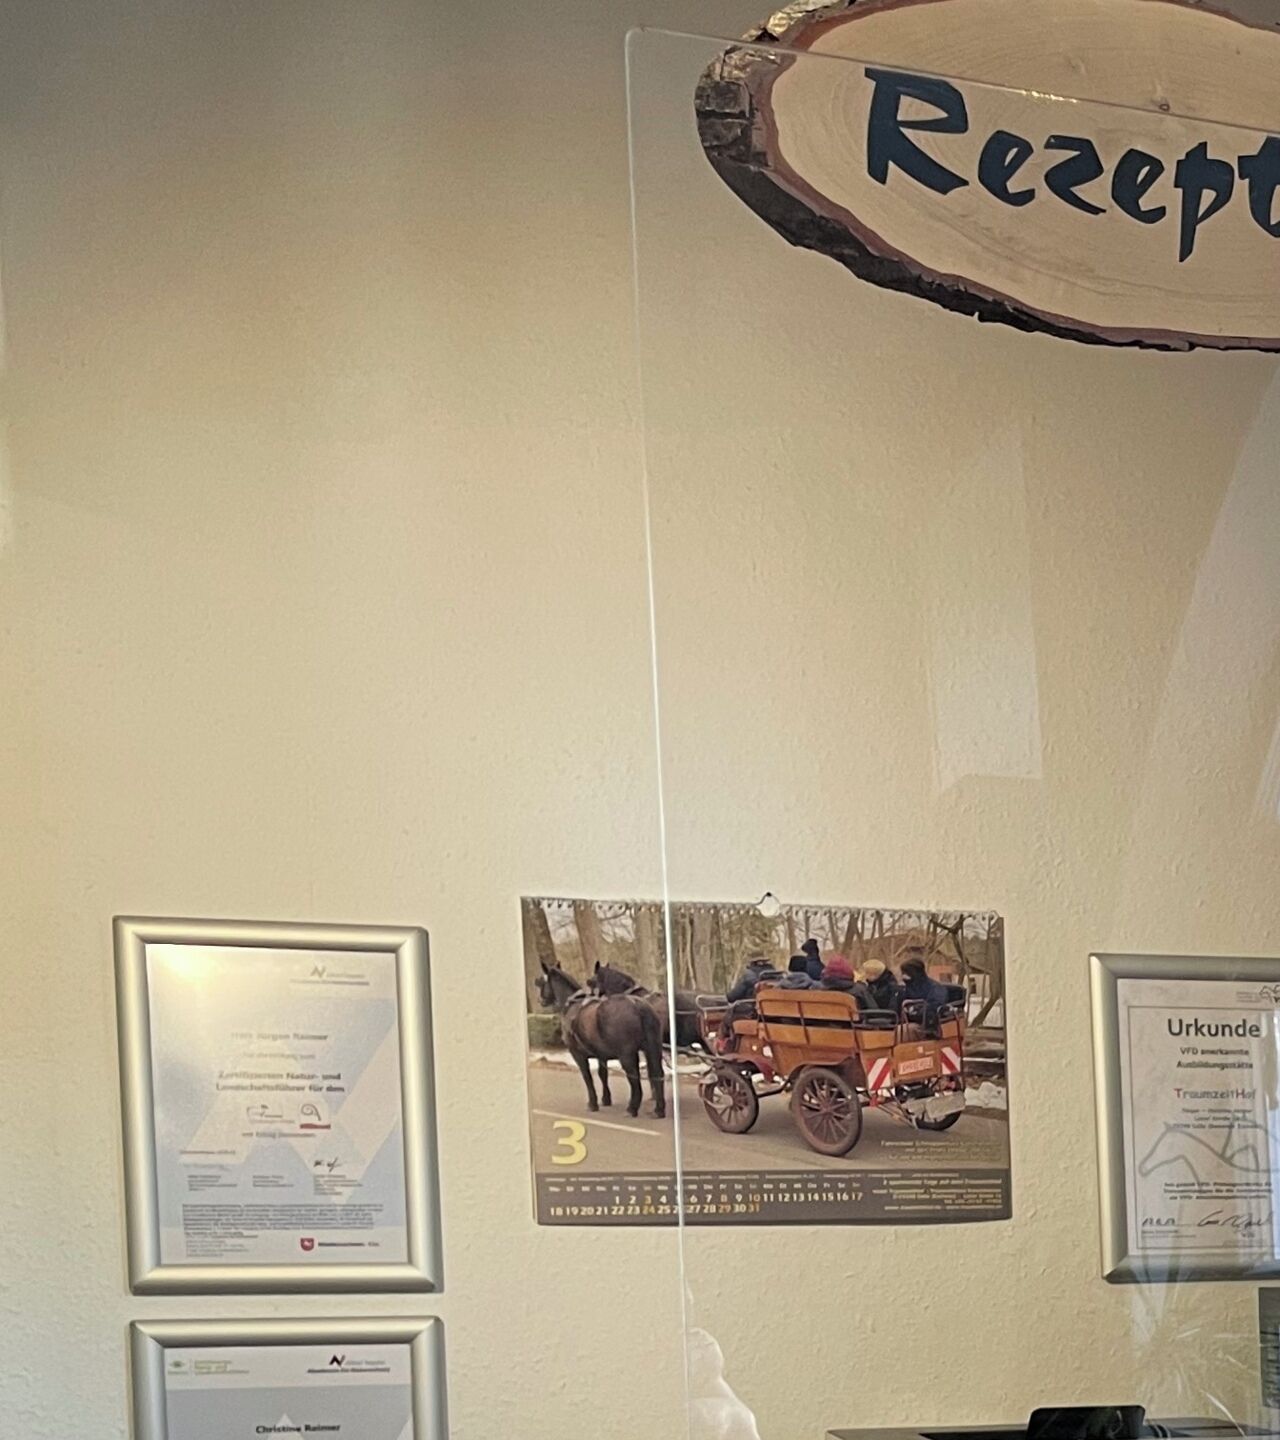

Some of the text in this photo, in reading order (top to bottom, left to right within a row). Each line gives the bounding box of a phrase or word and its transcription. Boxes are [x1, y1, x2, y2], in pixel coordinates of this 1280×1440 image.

[1168, 1018, 1261, 1038] Urkunde
[550, 1120, 588, 1165] 3
[256, 1425, 301, 1434] Christine
